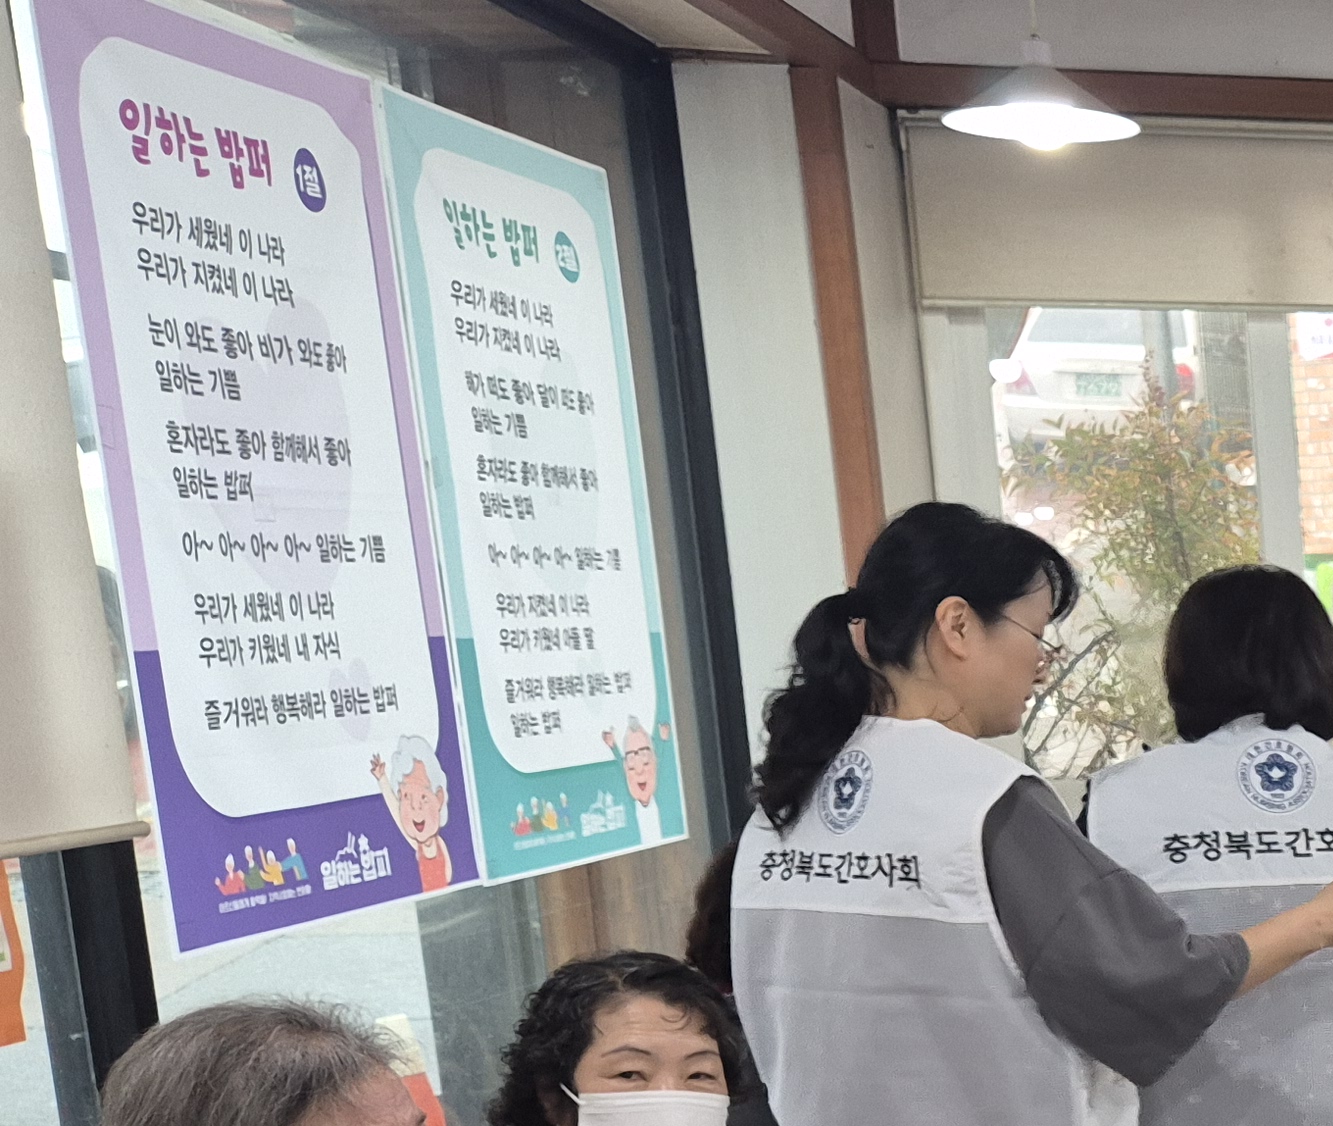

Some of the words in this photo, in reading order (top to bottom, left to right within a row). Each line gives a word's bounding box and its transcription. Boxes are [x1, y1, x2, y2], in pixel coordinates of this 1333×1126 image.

[119, 99, 210, 177] 일하는
[214, 127, 272, 189] 밥퍼
[296, 164, 322, 198] 1절
[132, 202, 182, 243] 우리가
[188, 216, 232, 255] 세웠네
[239, 229, 252, 259] 이
[258, 233, 285, 266] 나라
[443, 198, 497, 258] 일하는
[502, 217, 539, 267] 밥퍼
[137, 248, 187, 288] 우리가
[192, 260, 238, 298] 지켰네
[243, 271, 258, 302] 이
[262, 275, 295, 308] 나라
[451, 280, 486, 312] 우리가
[520, 299, 531, 323] 이
[149, 313, 181, 350] 눈이
[184, 321, 218, 353] 와도
[221, 327, 254, 361] 좋아
[257, 333, 294, 365] 비가
[297, 338, 323, 368] 와도
[325, 343, 347, 373] 좋아
[454, 316, 490, 348] 우리가
[524, 334, 536, 358] 이
[155, 360, 204, 396] 일하는
[208, 368, 241, 400] 기쁨
[165, 420, 232, 456] 혼자라도
[235, 428, 266, 461] 좋아
[271, 431, 321, 465] 함께해서
[323, 436, 351, 467] 좋아
[173, 467, 218, 500] 일하는
[224, 470, 254, 502] 밥퍼
[182, 530, 213, 562] 아~
[218, 531, 245, 562] 아~
[250, 532, 278, 562] 아~
[284, 533, 311, 562] 아~
[316, 533, 356, 563] 일하는
[360, 534, 386, 563] 기쁨
[194, 592, 238, 625] 우리가
[243, 591, 285, 623] 세웠네
[289, 591, 304, 621] 이
[307, 590, 335, 620] 나라
[199, 635, 244, 668] 우리가
[248, 633, 291, 665] 키웠네
[295, 632, 310, 661] 내
[312, 631, 341, 660] 자식
[205, 695, 269, 730] 즐거워라
[271, 690, 326, 724] 행복해라
[330, 687, 370, 717] 일하는
[373, 683, 399, 713] 밥퍼
[760, 849, 922, 889] 충청북도간호사회
